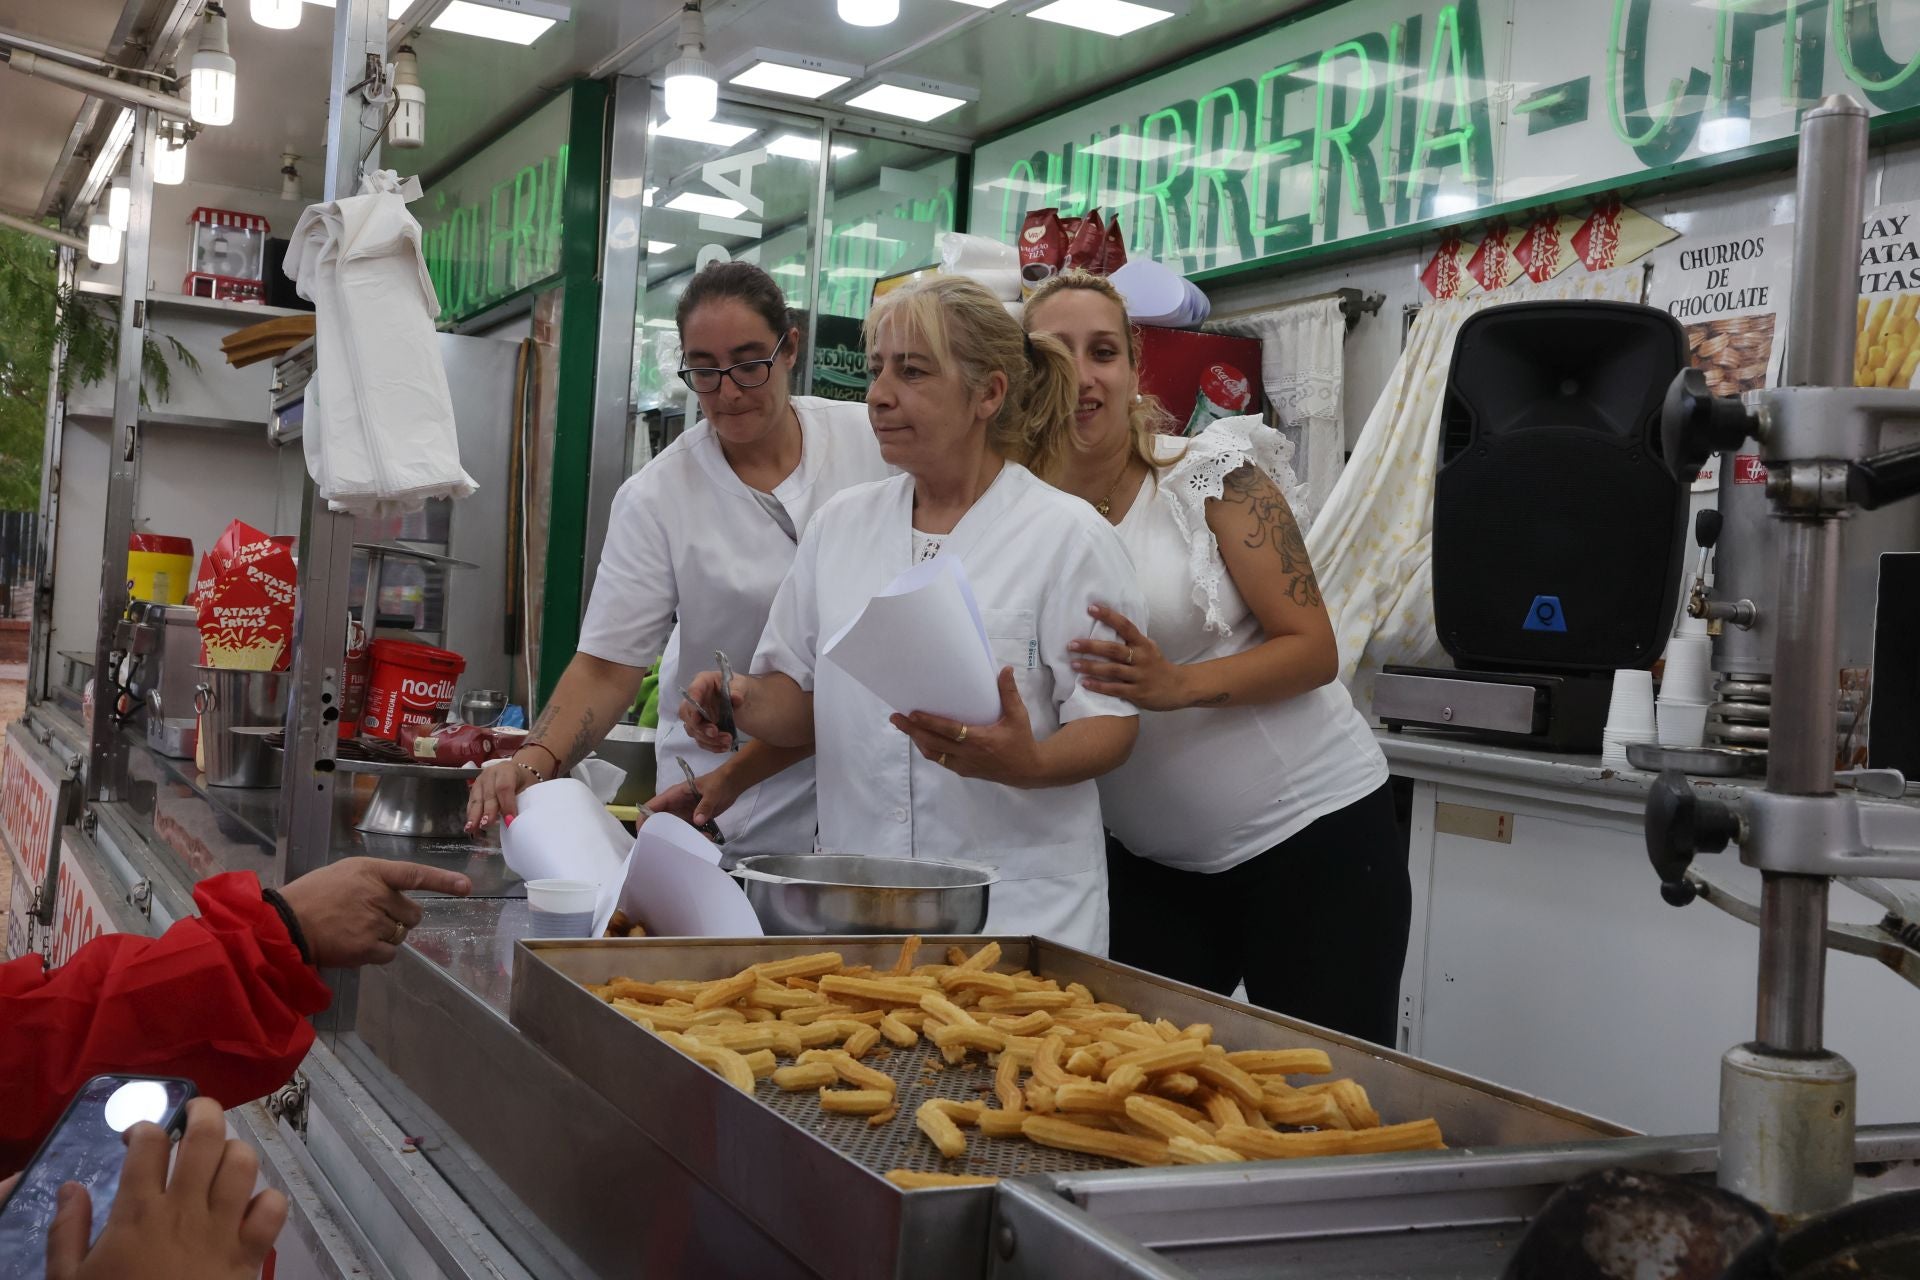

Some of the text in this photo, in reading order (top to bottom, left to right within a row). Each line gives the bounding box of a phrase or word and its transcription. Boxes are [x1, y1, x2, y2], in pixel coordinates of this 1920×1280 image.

[1680, 237, 1765, 271] CHURROS
[1706, 267, 1730, 290] DE
[1668, 286, 1769, 318] CHOCOLATE
[213, 606, 271, 618] PATATAS
[219, 616, 267, 628] FRITAS
[383, 690, 398, 735] PROFESIONAL
[403, 713, 432, 725] FLUIDA
